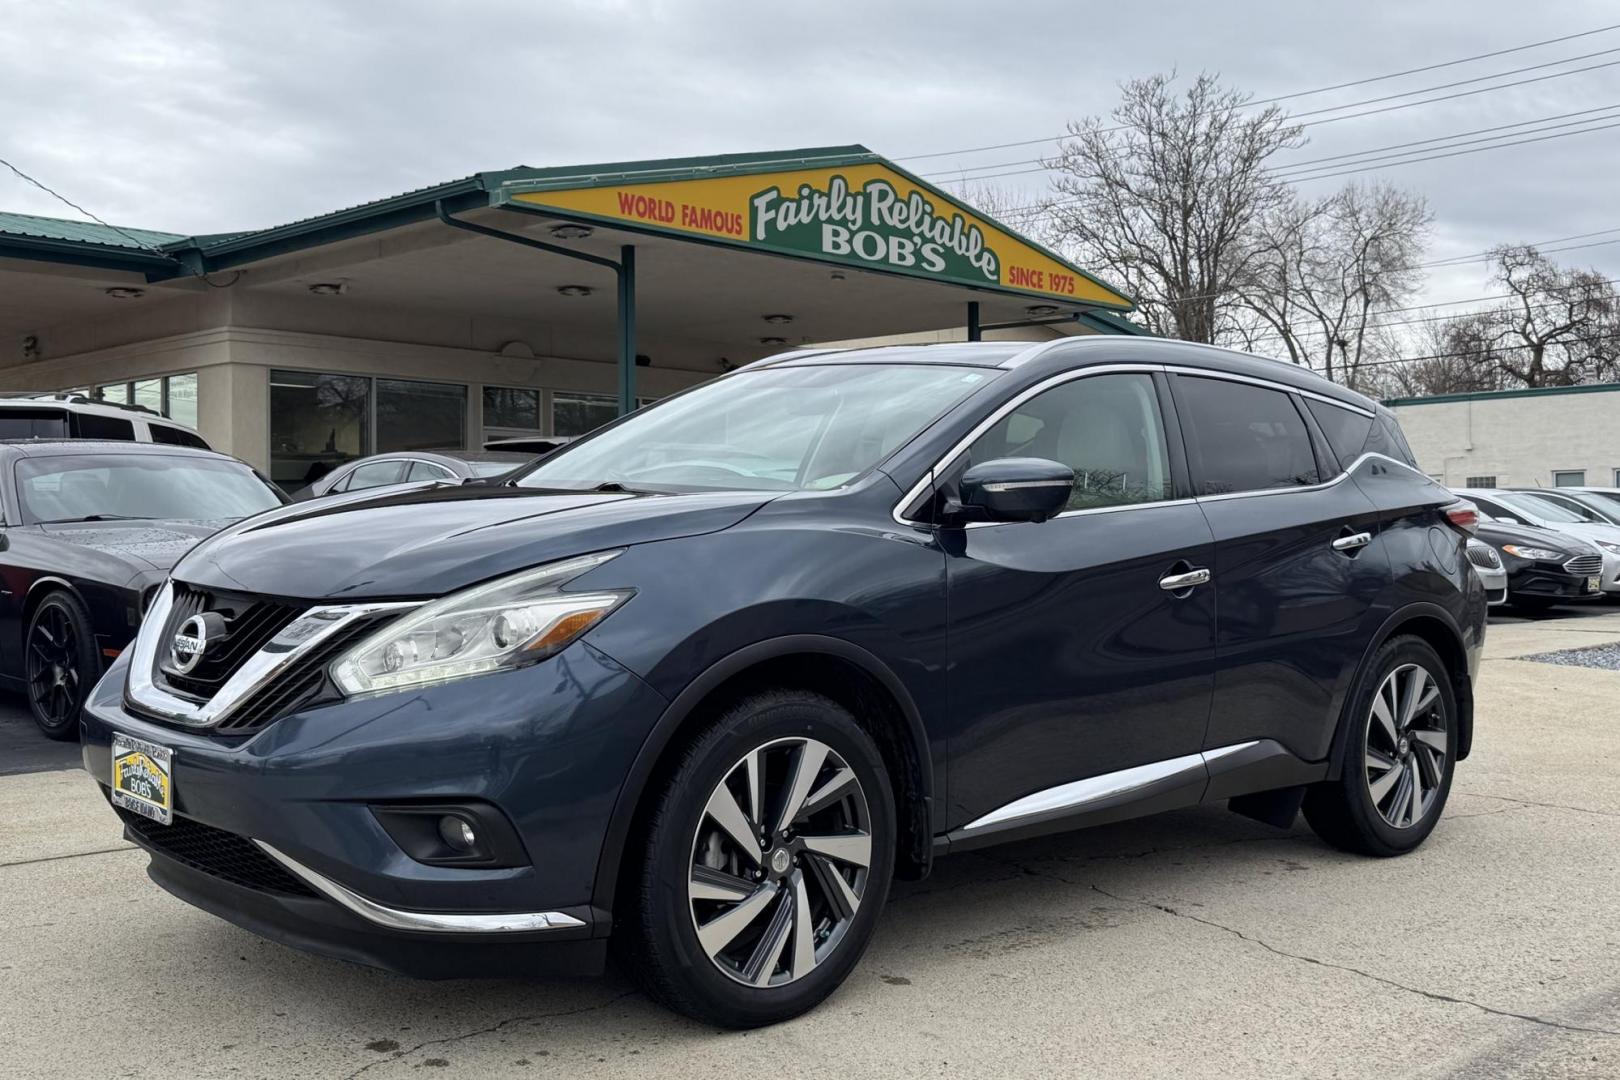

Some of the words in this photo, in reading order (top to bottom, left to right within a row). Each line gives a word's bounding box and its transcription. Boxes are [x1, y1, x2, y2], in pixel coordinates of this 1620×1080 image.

[617, 192, 675, 223] WORLD
[681, 204, 743, 235] FAMOUS
[753, 178, 864, 240] Fairly
[866, 182, 998, 280] Reliable
[822, 223, 946, 272] BOB'S
[1009, 265, 1043, 289] SINCE
[1049, 272, 1075, 295] 1975
[131, 777, 152, 799] BOB'S
